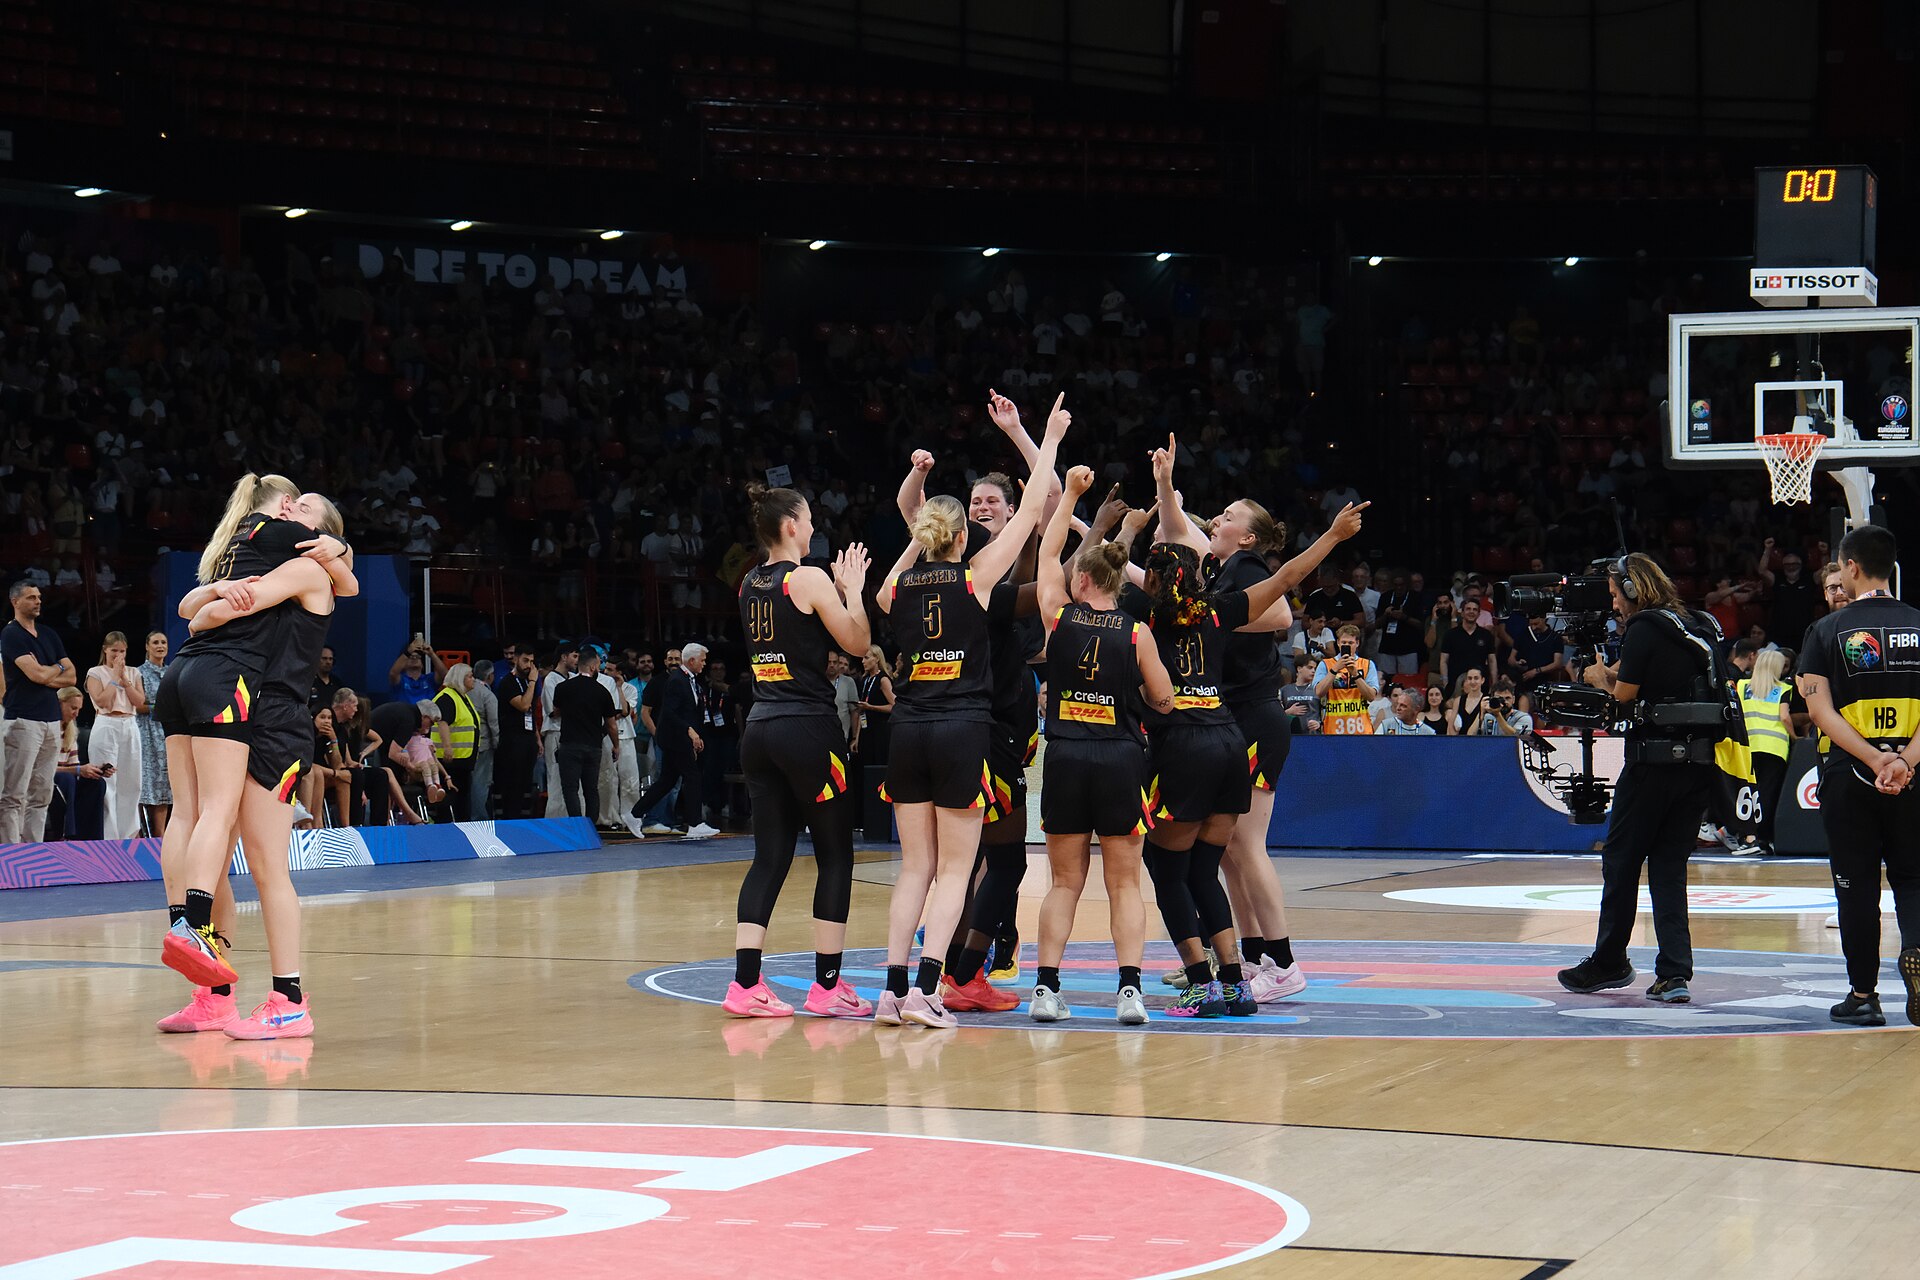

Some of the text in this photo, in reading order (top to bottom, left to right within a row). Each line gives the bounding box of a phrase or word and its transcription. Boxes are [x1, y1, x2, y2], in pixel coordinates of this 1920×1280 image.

[478, 252, 537, 289] TO
[548, 256, 687, 299] DREAM
[1784, 275, 1859, 288] TISSOT
[1693, 423, 1709, 431] FIBA
[747, 596, 774, 642] 99
[922, 592, 943, 640] 5
[1889, 633, 1919, 648] FIBA
[922, 649, 965, 661] crelan
[1078, 635, 1101, 681] 4
[917, 666, 957, 675] DHL
[1183, 685, 1218, 696] crelan
[1074, 691, 1115, 705] crelan
[1069, 706, 1108, 719] DHL
[1874, 707, 1897, 729] HB
[1335, 717, 1365, 735] 368
